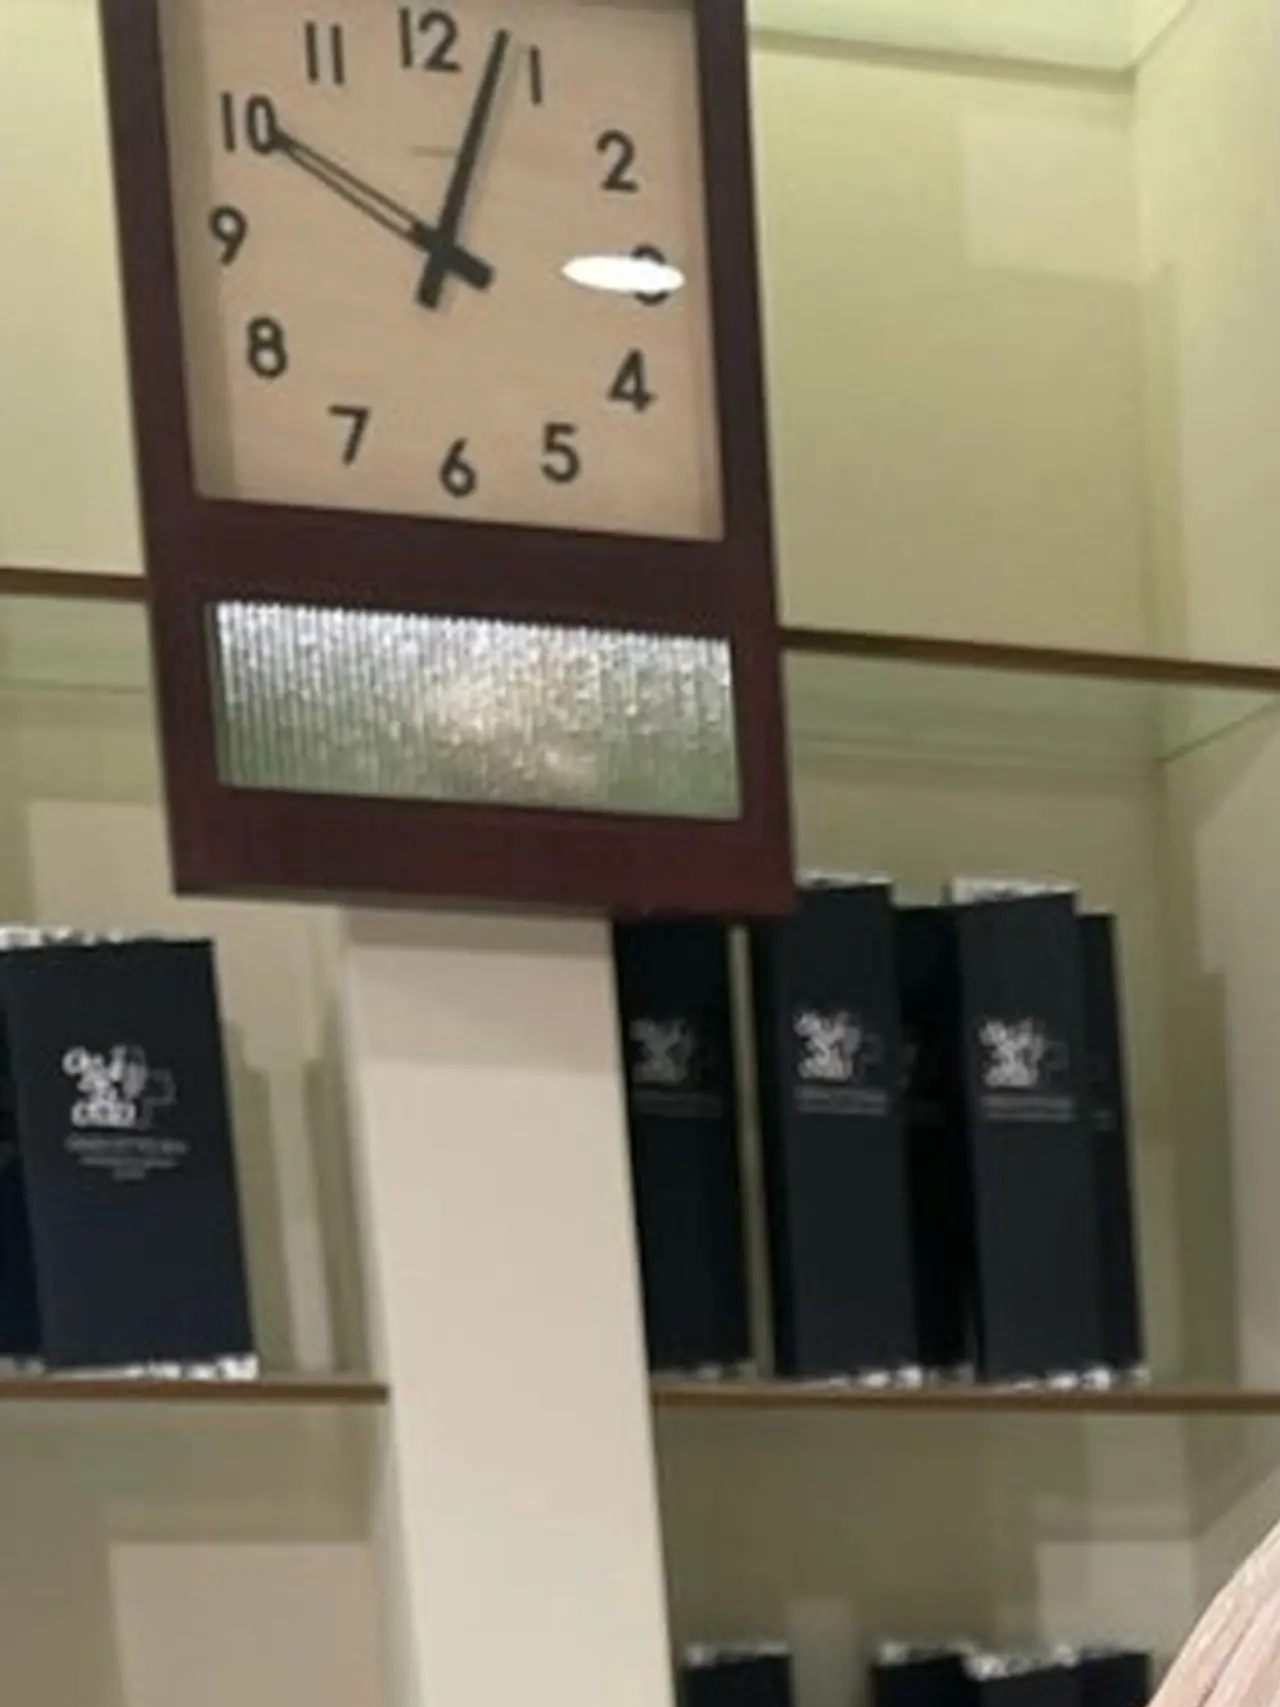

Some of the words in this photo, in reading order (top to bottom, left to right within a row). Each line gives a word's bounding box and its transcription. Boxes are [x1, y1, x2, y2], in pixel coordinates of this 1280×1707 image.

[304, 21, 345, 86] 11
[398, 7, 462, 73] 12
[528, 45, 543, 105] 1
[221, 92, 277, 156] 10
[596, 130, 639, 193] 2
[207, 205, 248, 266] 9
[246, 316, 289, 380] 8
[607, 348, 654, 412] 4
[328, 404, 370, 465] 7
[540, 422, 581, 485] 5
[438, 438, 478, 499] 6
